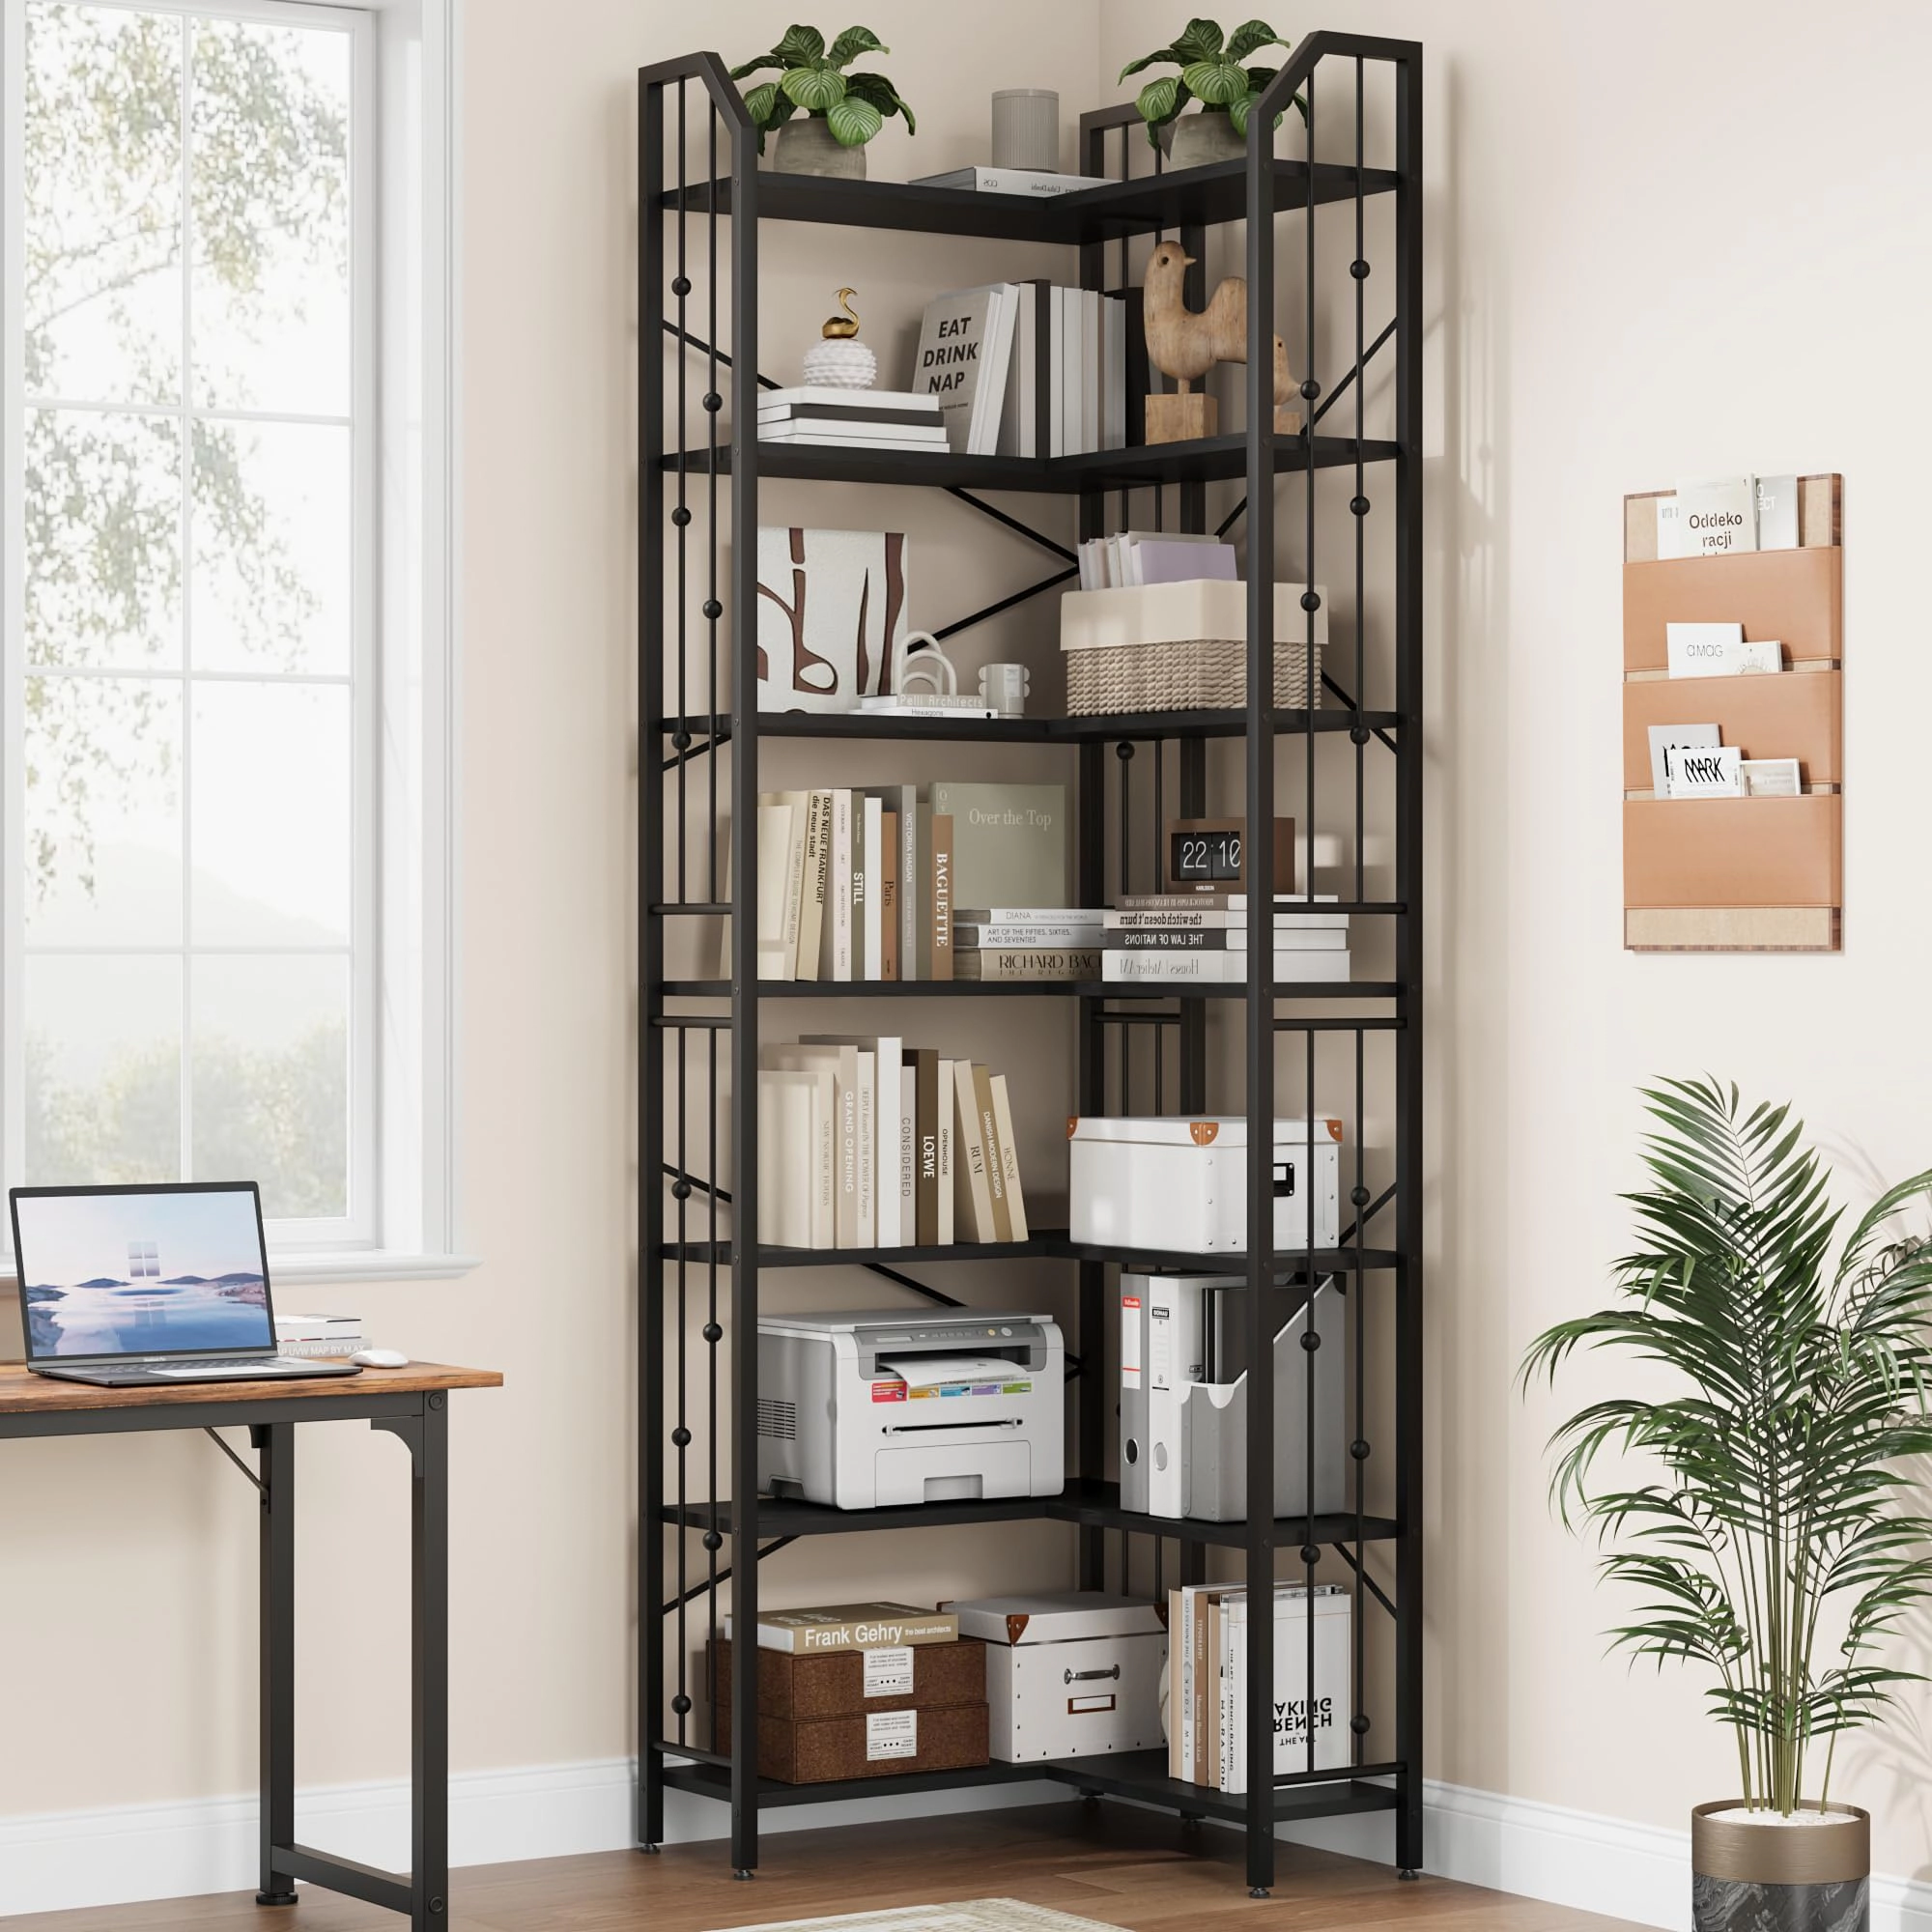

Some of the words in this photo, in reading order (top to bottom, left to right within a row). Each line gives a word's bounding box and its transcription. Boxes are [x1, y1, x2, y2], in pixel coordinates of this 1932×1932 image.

[938, 316, 972, 339] EAT
[923, 342, 980, 368] DRINK
[927, 371, 965, 394] NAP
[1689, 512, 1743, 529] Oddeko
[1702, 531, 1732, 550] racji
[899, 695, 923, 706] Pelli
[928, 695, 983, 708] Architects
[911, 708, 944, 718] Hexagons
[1684, 756, 1725, 782] MARK
[822, 797, 831, 817] DAS
[969, 809, 1000, 825] Over
[1004, 810, 1023, 826] the
[1026, 810, 1052, 831] Top
[820, 819, 829, 845] NEUE
[815, 848, 826, 905] FRANKFURT
[853, 872, 864, 905] STILL
[884, 881, 895, 907] Paris
[936, 852, 949, 947] BAGUETTE
[999, 954, 1064, 969] RICHARD
[1069, 954, 1101, 969] BAC
[845, 1091, 854, 1134] GRAND
[983, 1111, 994, 1139] DANISH
[845, 1138, 854, 1193] OPENING
[901, 1117, 911, 1197] CONSIDERED
[923, 1136, 935, 1179] LOEWE
[970, 1145, 983, 1175] RUM
[987, 1140, 999, 1172] MODERN
[1004, 1147, 1015, 1181] HONNE
[992, 1172, 1003, 1199] DESIGN
[289, 1347, 309, 1356] UVW
[310, 1346, 328, 1355] MAP
[330, 1346, 342, 1354] BY
[805, 1628, 850, 1647] Frank
[854, 1624, 903, 1647] Gehry
